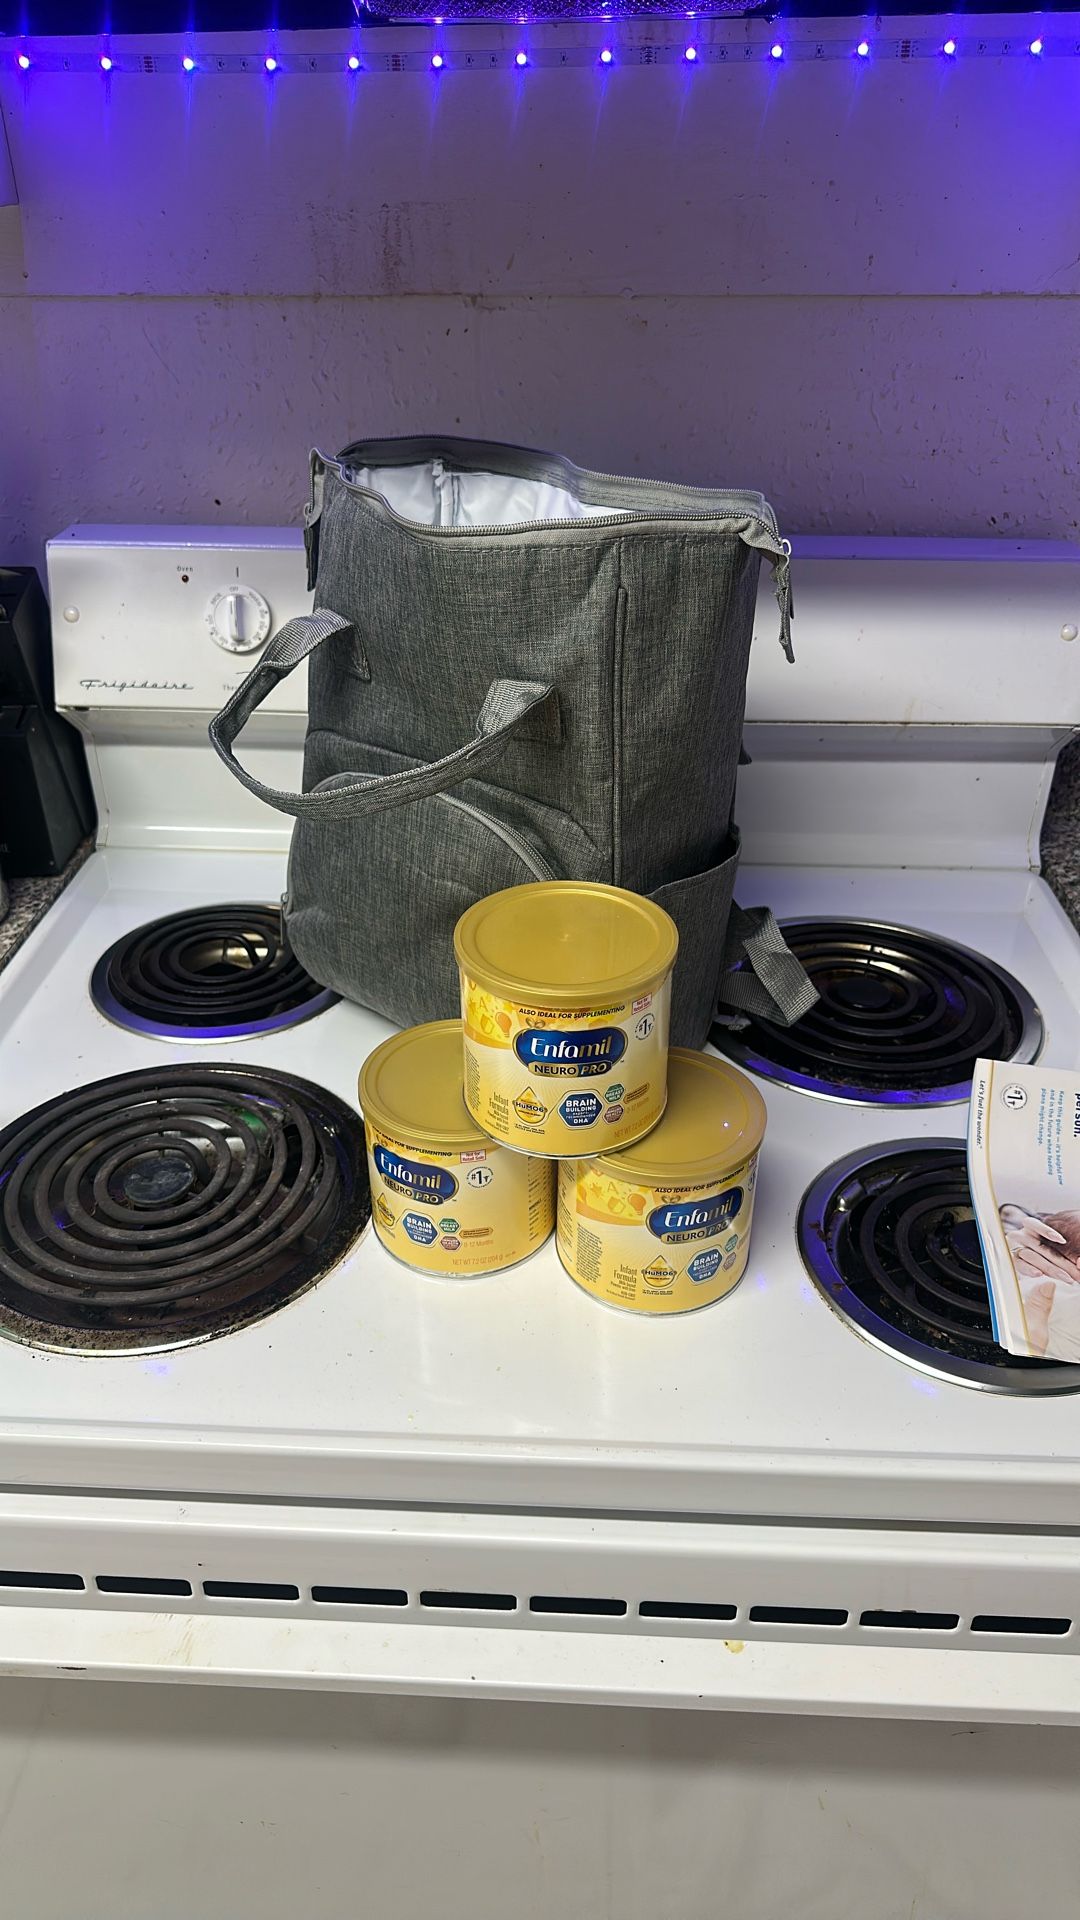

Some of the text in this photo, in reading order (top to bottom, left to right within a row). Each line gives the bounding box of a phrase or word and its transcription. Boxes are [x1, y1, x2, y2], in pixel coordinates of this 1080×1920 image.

[80, 679, 194, 692] Frigidaire
[519, 1007, 536, 1016] ALSO
[537, 1011, 557, 1019] IDEAL
[573, 1005, 626, 1019] SUPPLEMENTING
[531, 1035, 612, 1059] Enfamil
[565, 1098, 597, 1107] BRAIN
[565, 1105, 597, 1113] BUILDING
[406, 1144, 453, 1157] SUPPLEMENTING
[380, 1152, 441, 1189] Enfamil
[664, 1195, 734, 1227] Enfamil
[406, 1216, 432, 1229] BRAIN
[407, 1222, 433, 1234] BUILDING
[693, 1252, 719, 1266] BRAIN
[613, 1269, 637, 1284] Formula
[620, 1264, 637, 1276] Infant
